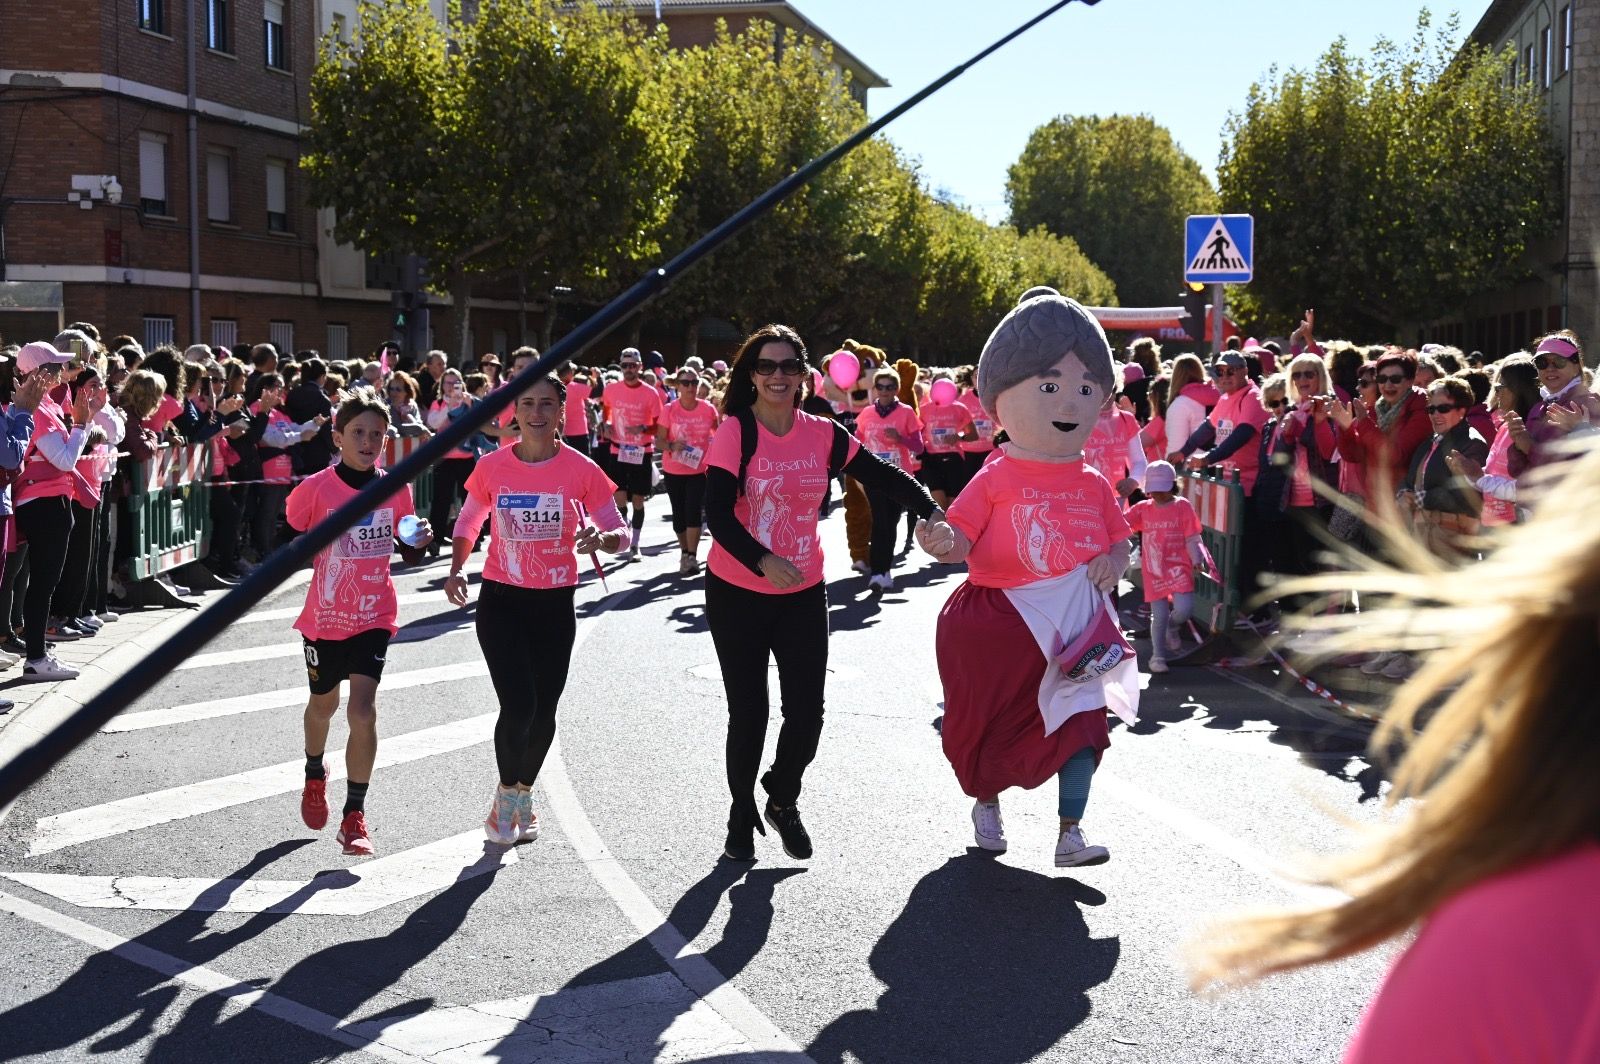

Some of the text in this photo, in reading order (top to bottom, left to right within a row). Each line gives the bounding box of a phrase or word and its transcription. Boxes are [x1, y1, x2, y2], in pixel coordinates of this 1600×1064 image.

[522, 510, 560, 523] 3114
[358, 525, 392, 540] 3113
[1094, 648, 1121, 675] Rogelia
